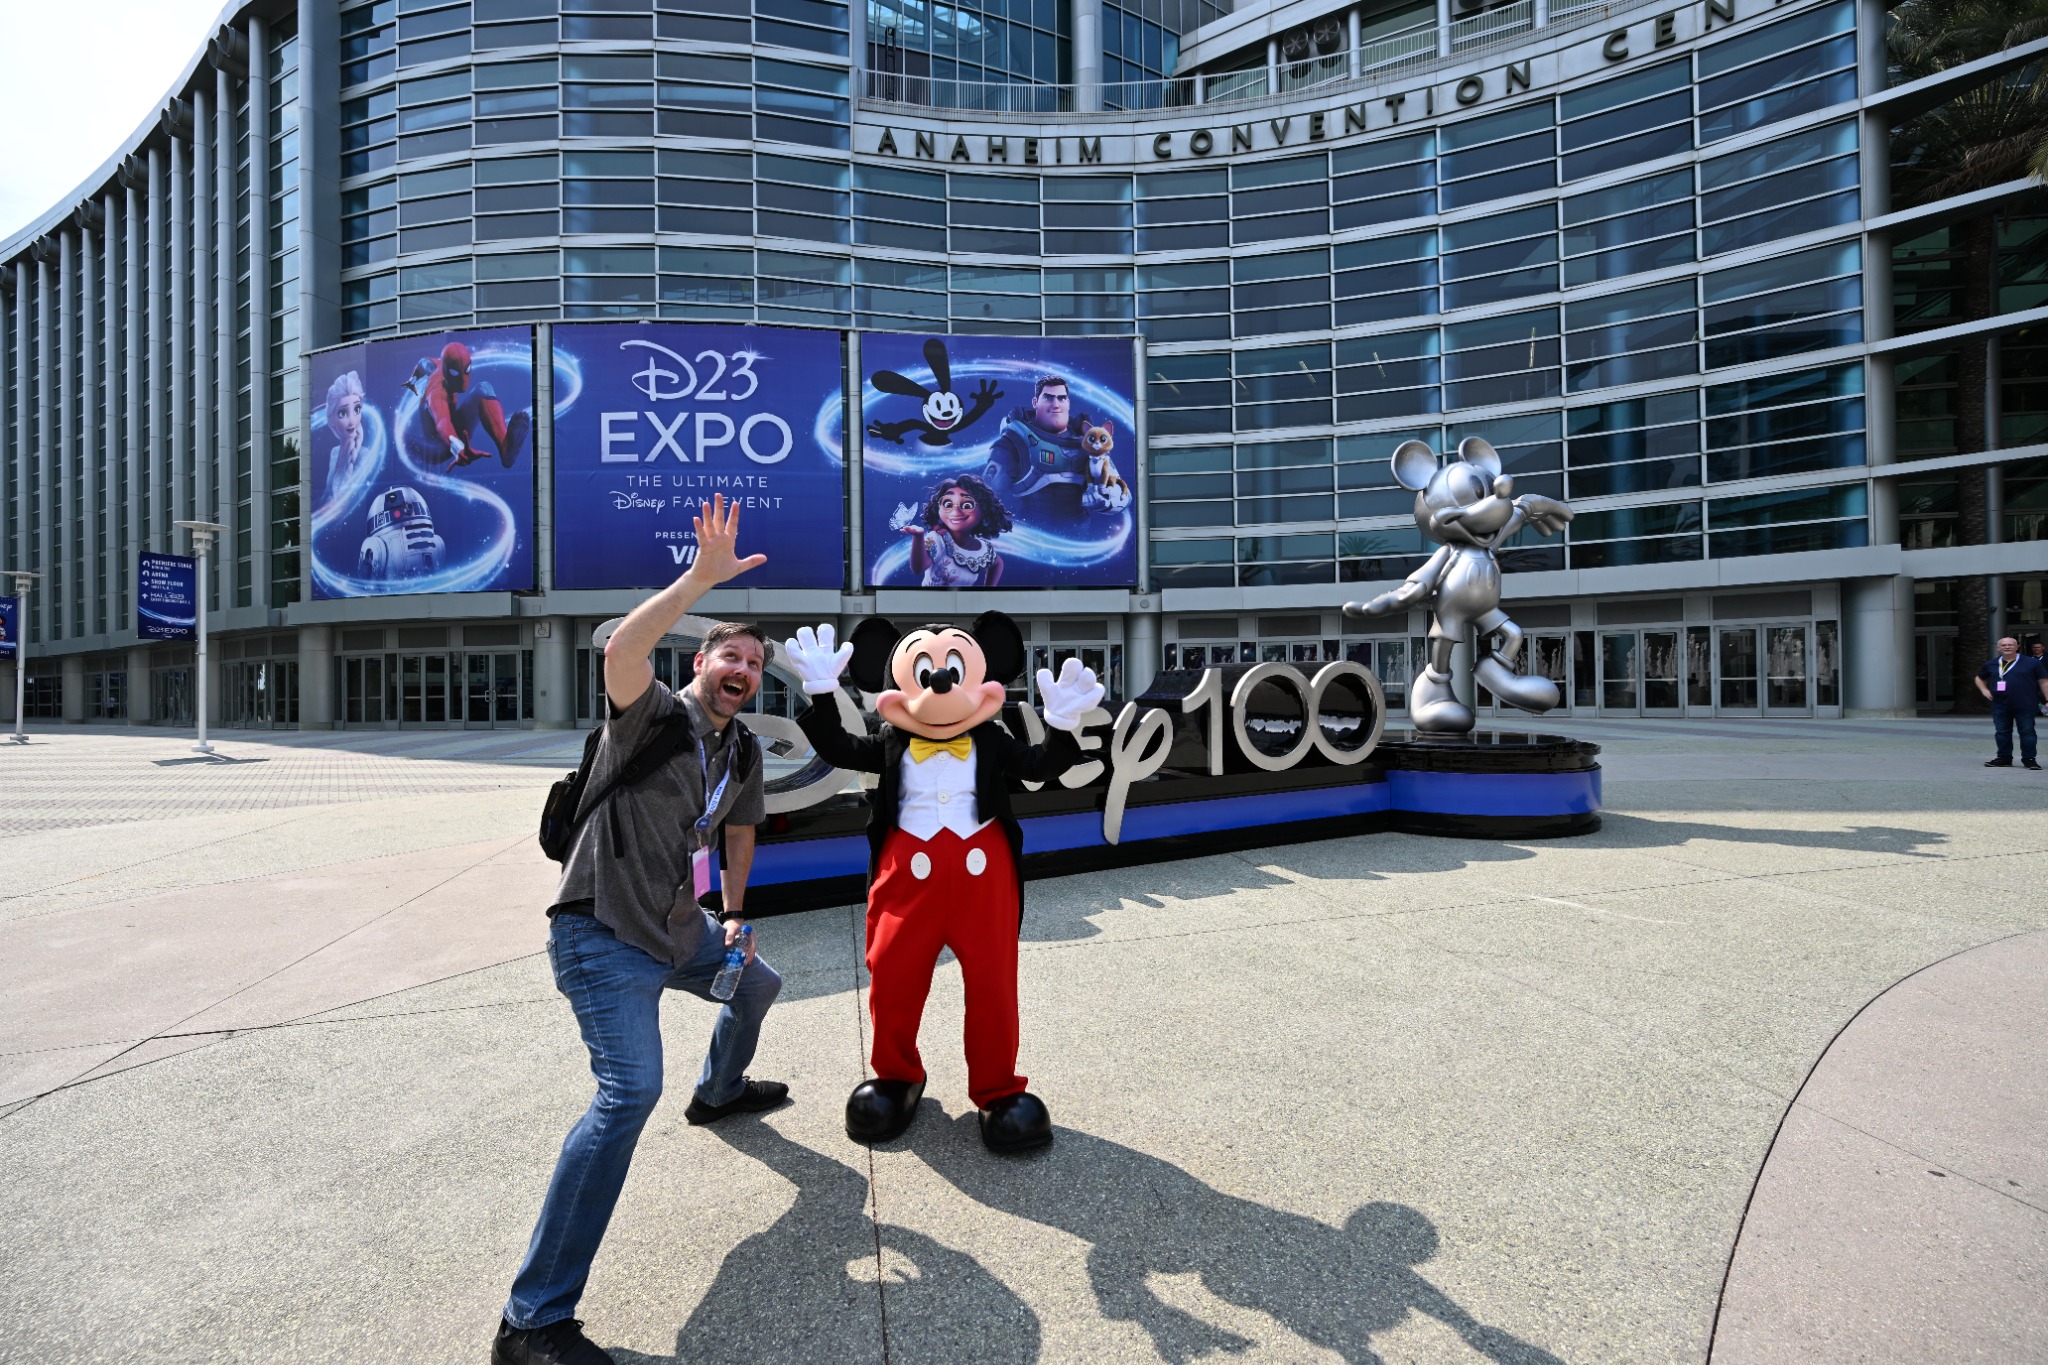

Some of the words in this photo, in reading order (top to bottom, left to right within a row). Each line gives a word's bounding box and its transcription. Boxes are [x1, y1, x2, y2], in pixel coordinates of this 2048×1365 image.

[877, 127, 1102, 164] ANAHEIM
[1153, 59, 1532, 158] CONVENTION
[1602, 0, 1783, 61] CEN
[619, 340, 760, 402] D23
[600, 411, 793, 465] EXPO
[626, 475, 662, 487] THE
[672, 475, 768, 488] ULTIMATE
[608, 491, 666, 515] Disney
[672, 496, 709, 508] FAN
[655, 531, 699, 539] PRESEN
[666, 545, 696, 565] VI
